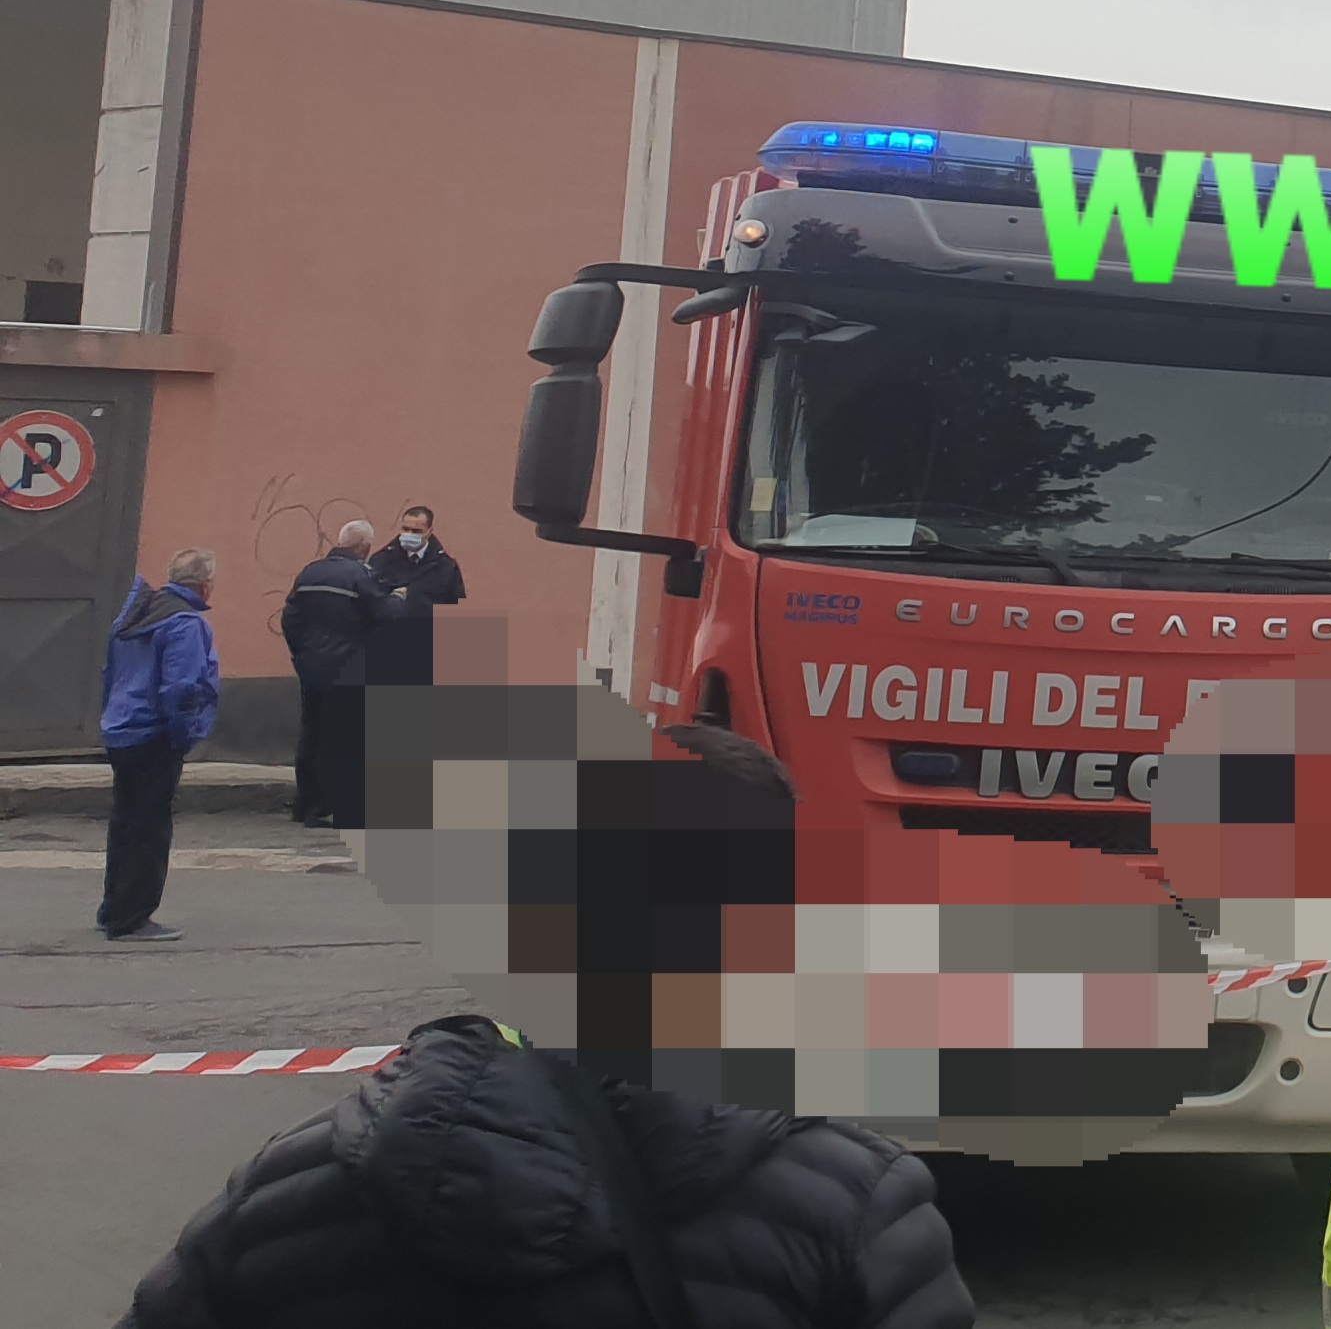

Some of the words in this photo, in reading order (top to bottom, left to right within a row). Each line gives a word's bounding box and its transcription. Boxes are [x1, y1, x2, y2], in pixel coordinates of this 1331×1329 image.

[786, 592, 861, 610] IVECO
[801, 661, 1009, 724] VIGILI
[1032, 672, 1159, 730] DEL
[978, 748, 1159, 802] IVEC
